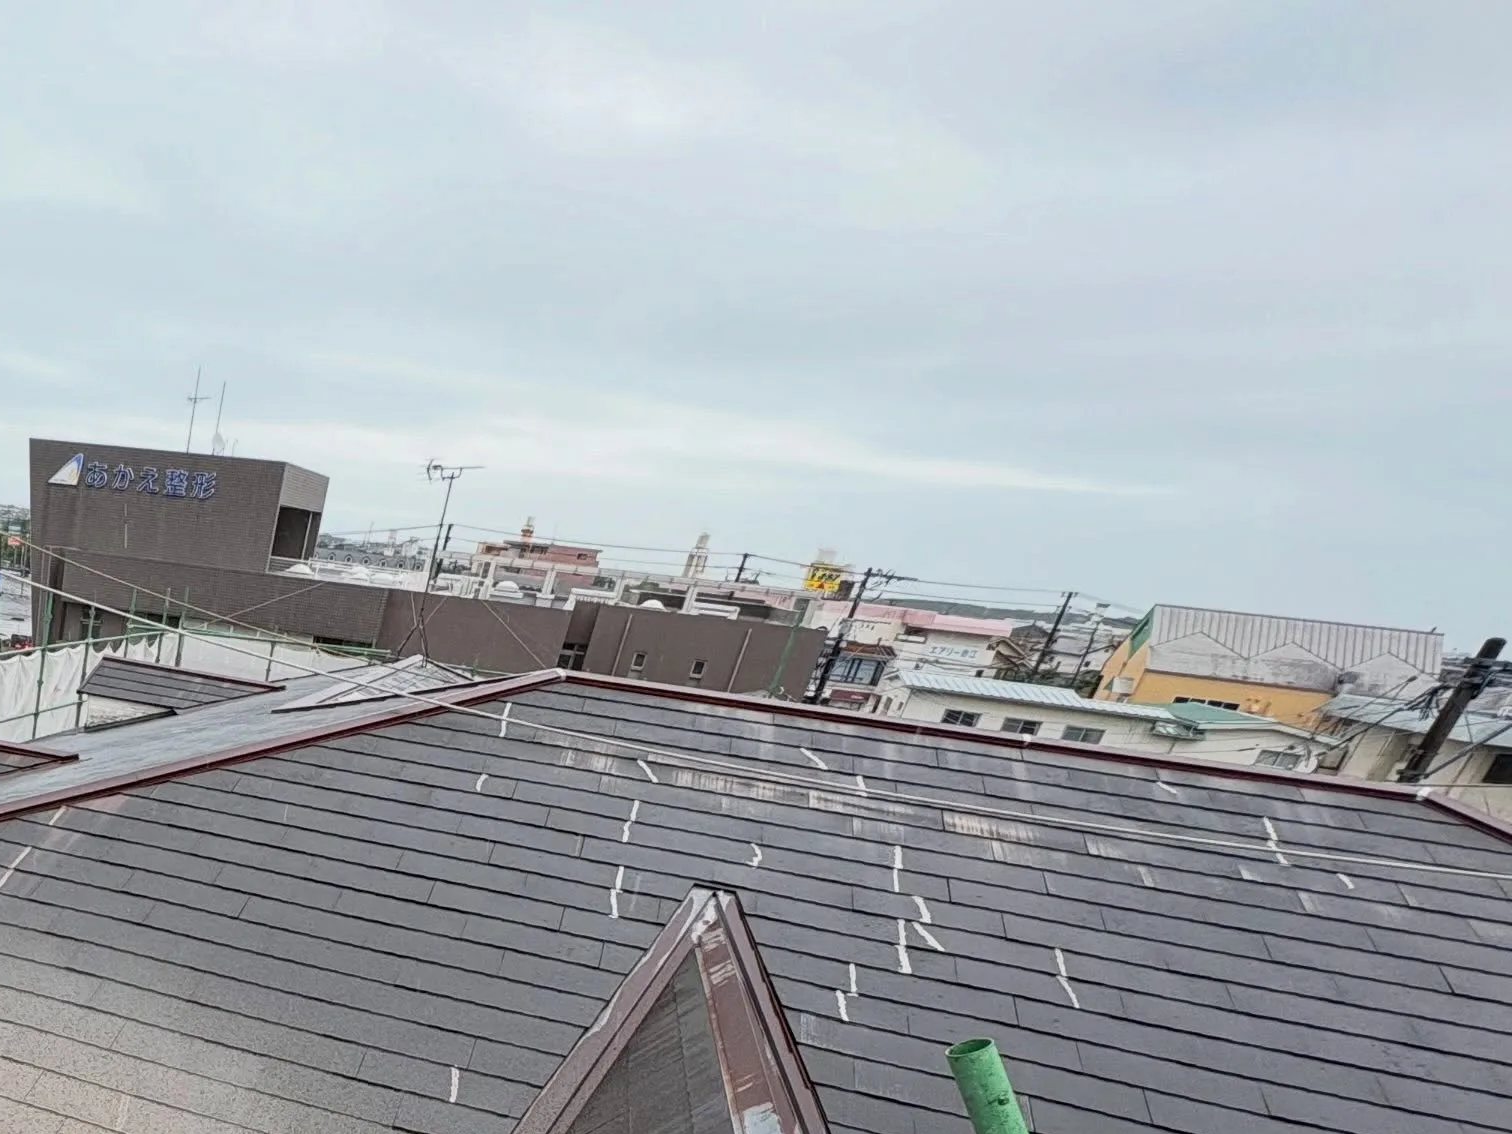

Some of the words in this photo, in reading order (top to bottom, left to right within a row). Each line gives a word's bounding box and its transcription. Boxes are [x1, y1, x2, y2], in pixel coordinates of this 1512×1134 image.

[85, 461, 216, 499] あかえ整形
